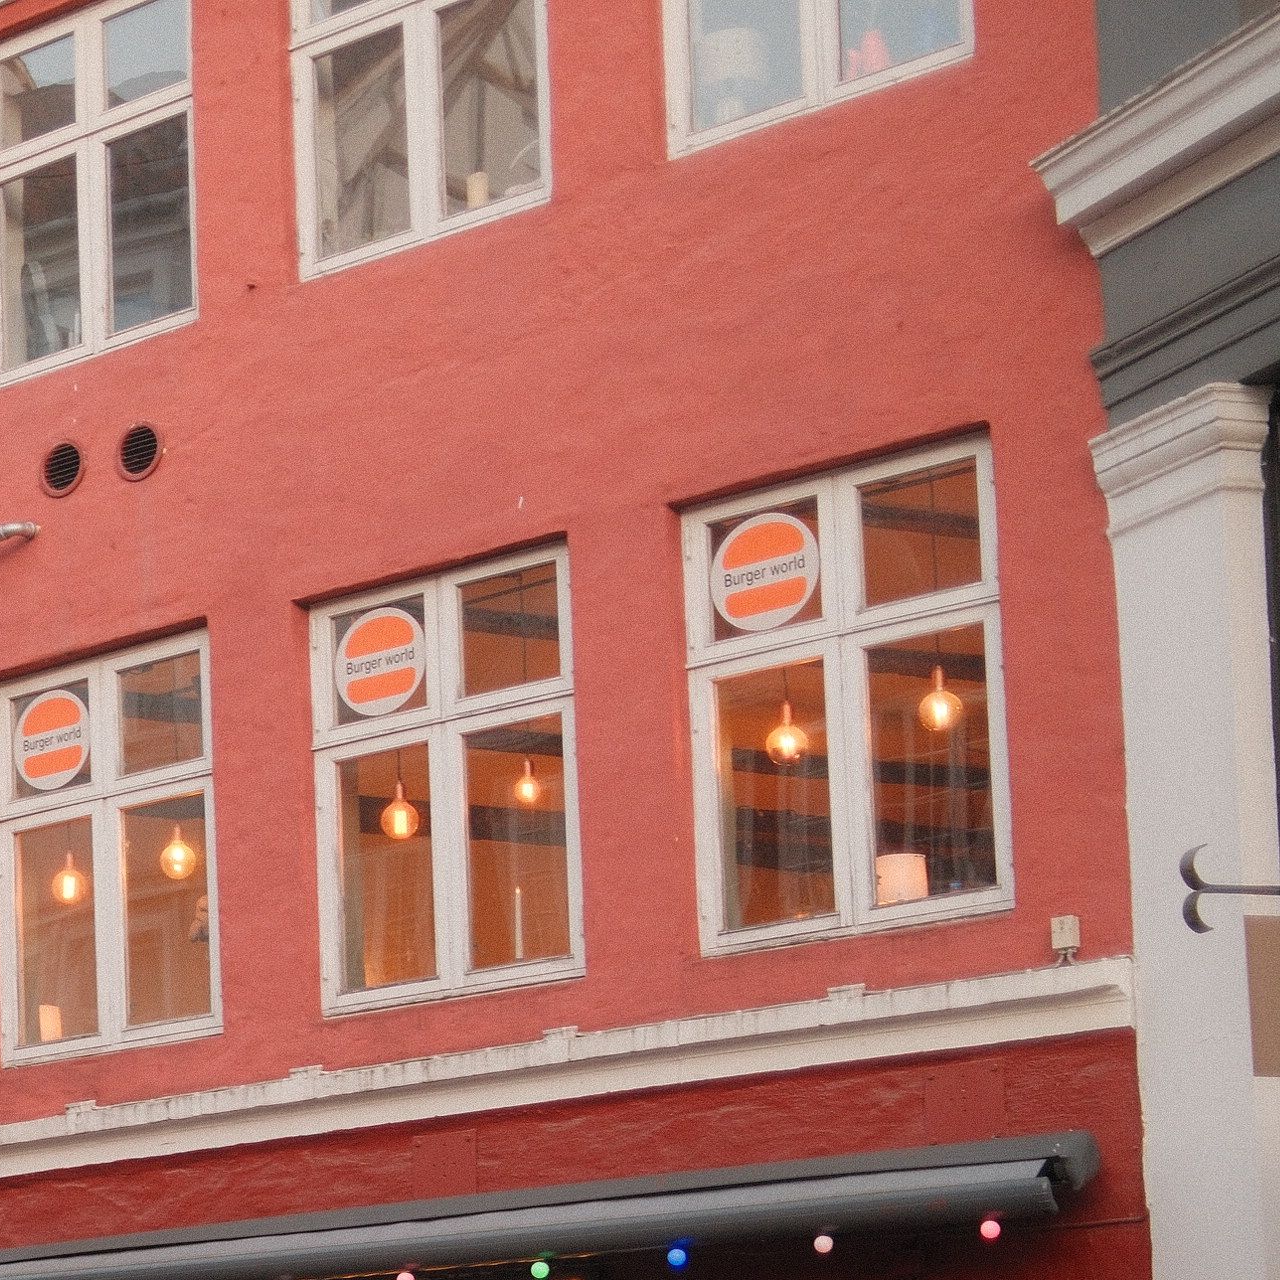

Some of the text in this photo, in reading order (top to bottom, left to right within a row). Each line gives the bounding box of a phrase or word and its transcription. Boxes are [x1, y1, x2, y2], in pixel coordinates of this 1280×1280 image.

[724, 554, 806, 588] Burger world
[346, 647, 415, 675] Burger world
[23, 726, 82, 752] Burger world
